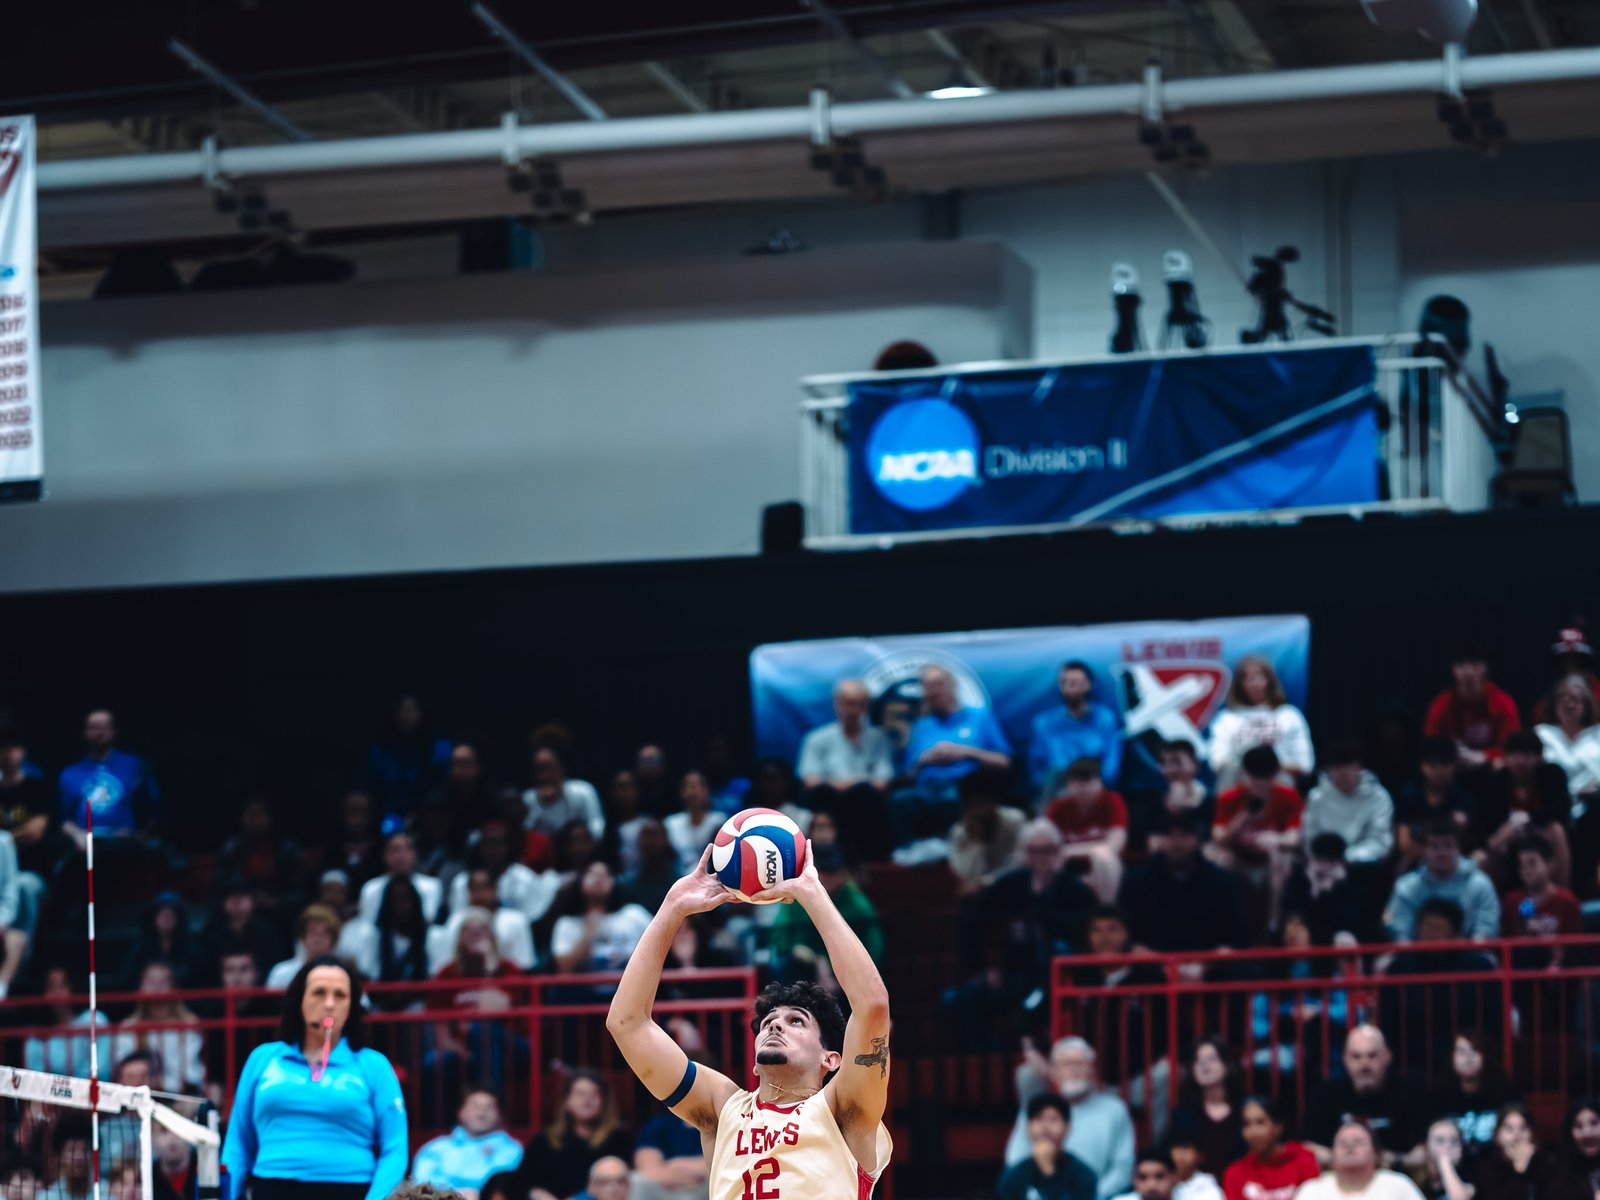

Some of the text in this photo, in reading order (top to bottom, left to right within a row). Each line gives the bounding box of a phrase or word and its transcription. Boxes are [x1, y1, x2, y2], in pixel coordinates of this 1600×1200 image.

[985, 443, 1102, 478] Division
[765, 850, 777, 884] NCAA
[735, 1121, 800, 1156] LEWS
